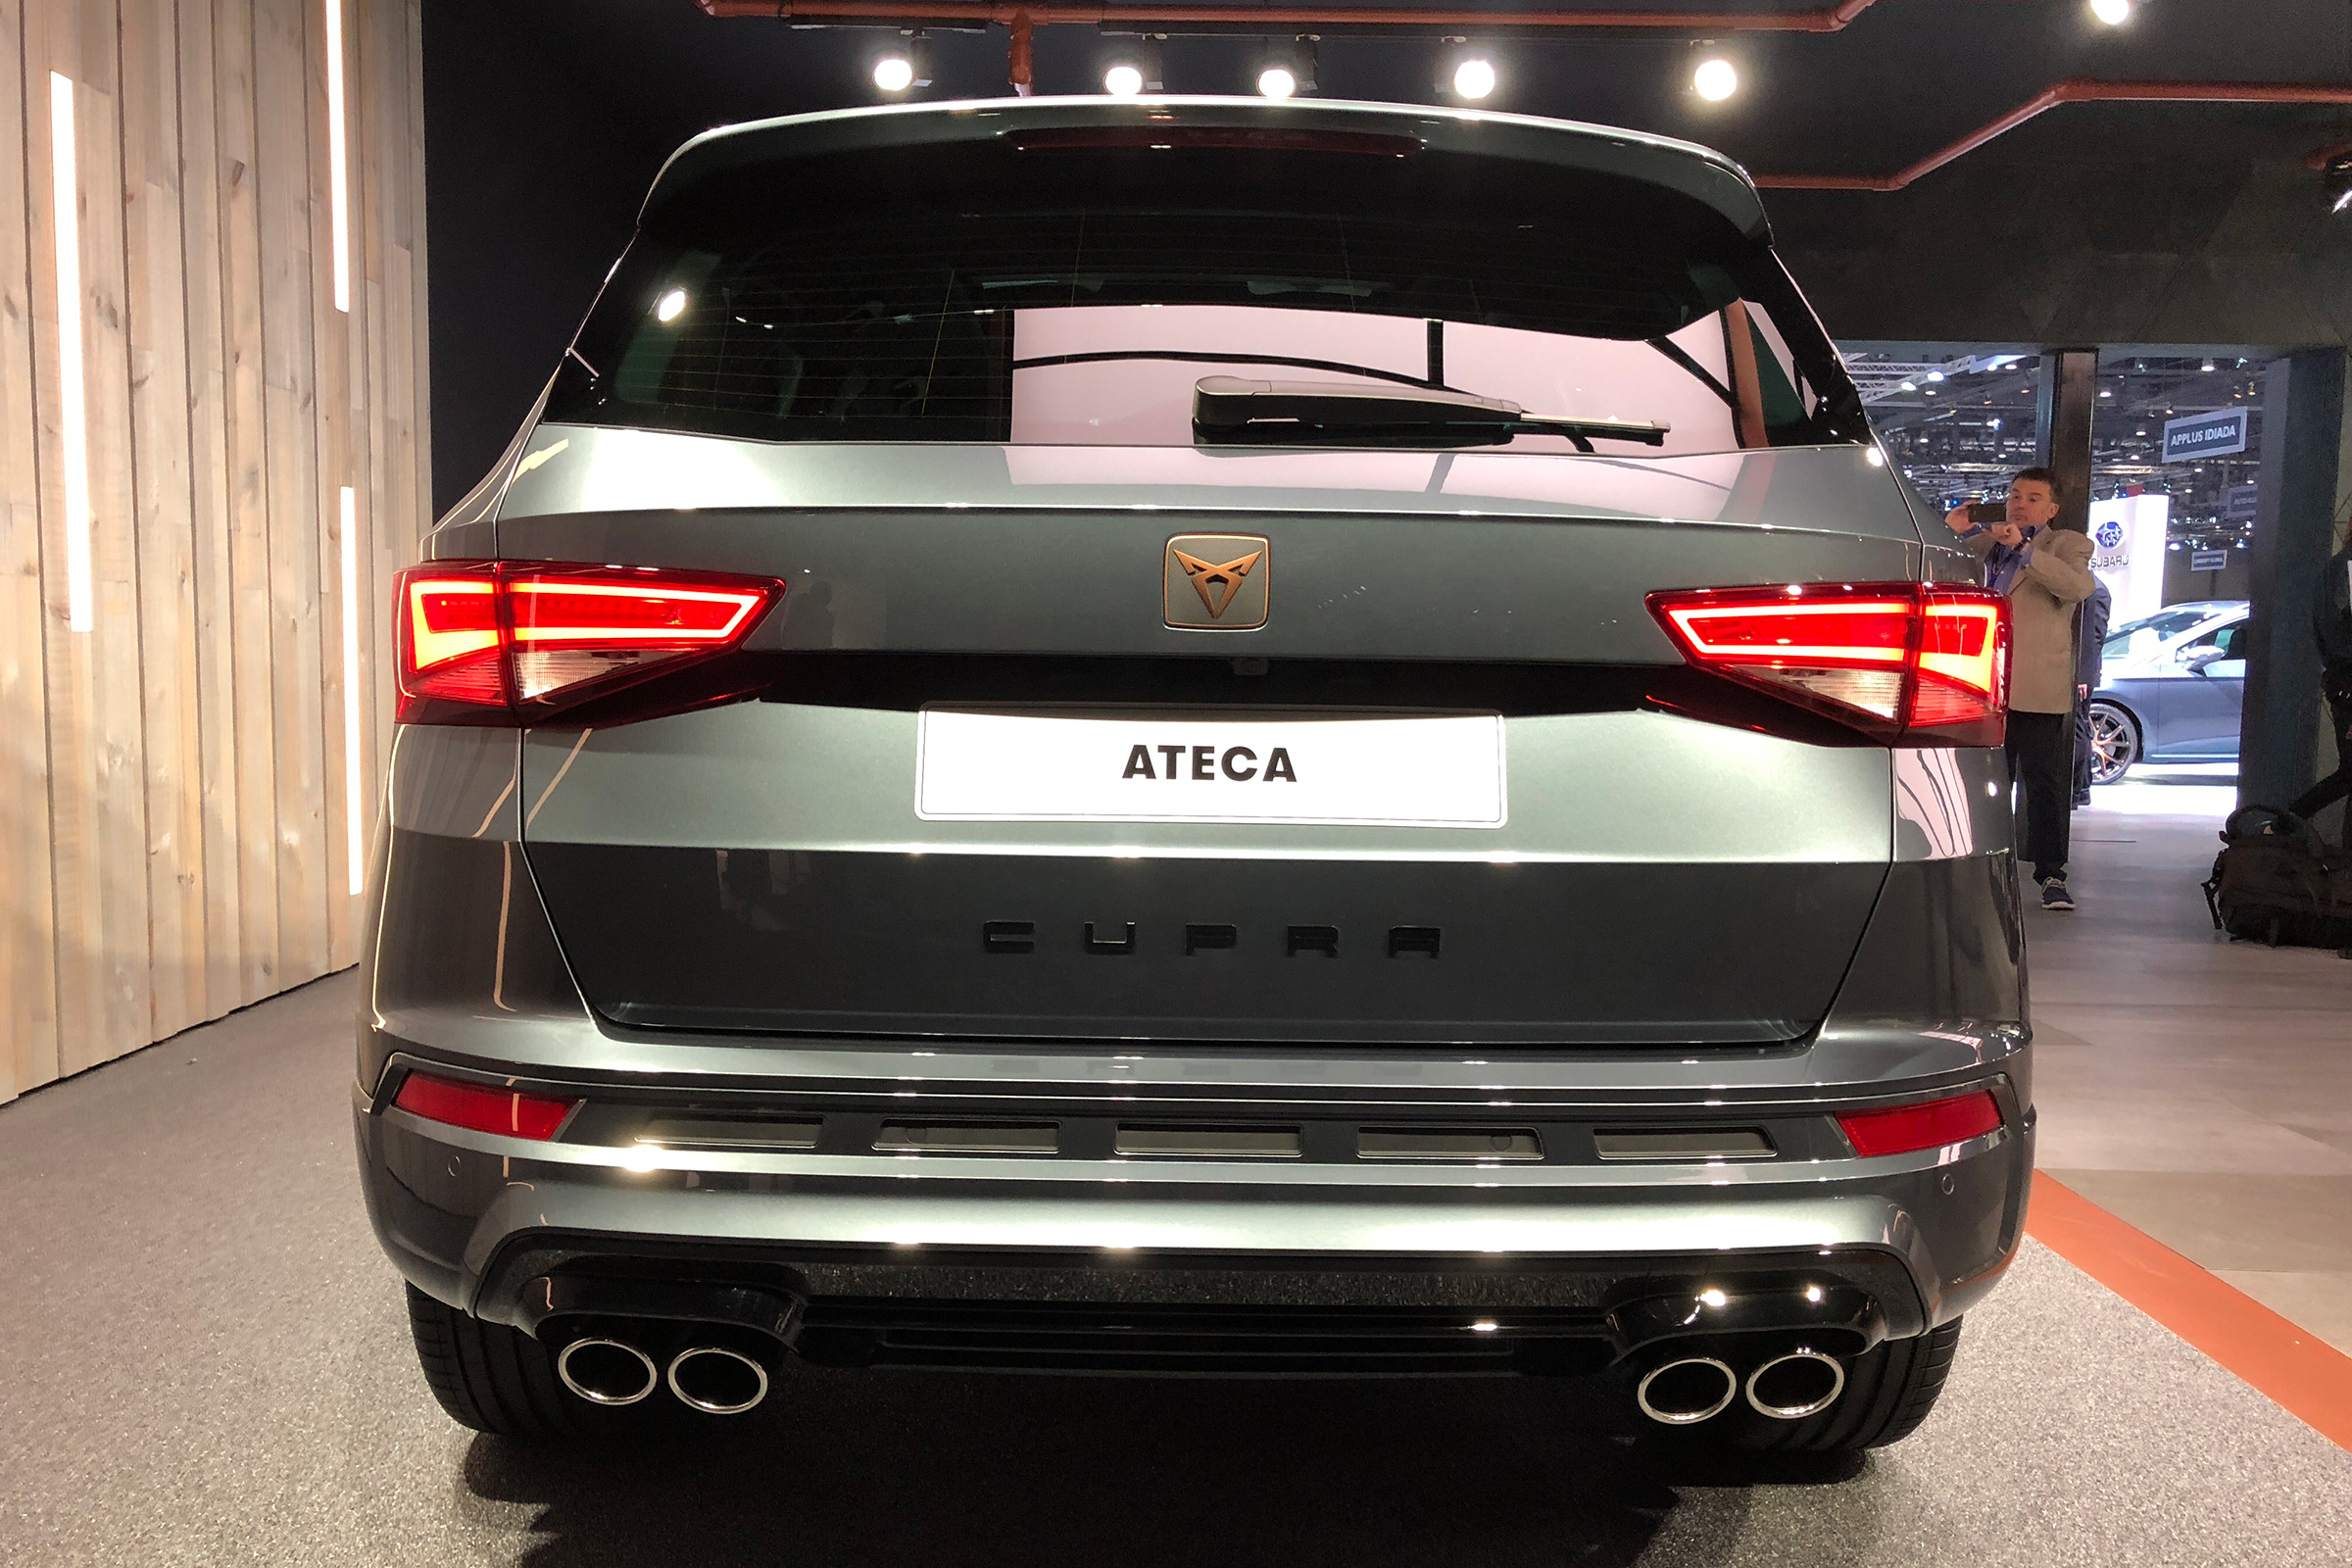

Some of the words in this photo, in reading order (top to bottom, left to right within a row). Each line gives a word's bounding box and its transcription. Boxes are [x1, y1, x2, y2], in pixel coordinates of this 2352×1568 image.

[2171, 430, 2203, 446] APPLUS
[2204, 424, 2235, 441] IDIADA
[2090, 555, 2130, 568] SUBARU
[1122, 744, 1298, 782] ATECA
[983, 920, 1442, 958] CUPRA
